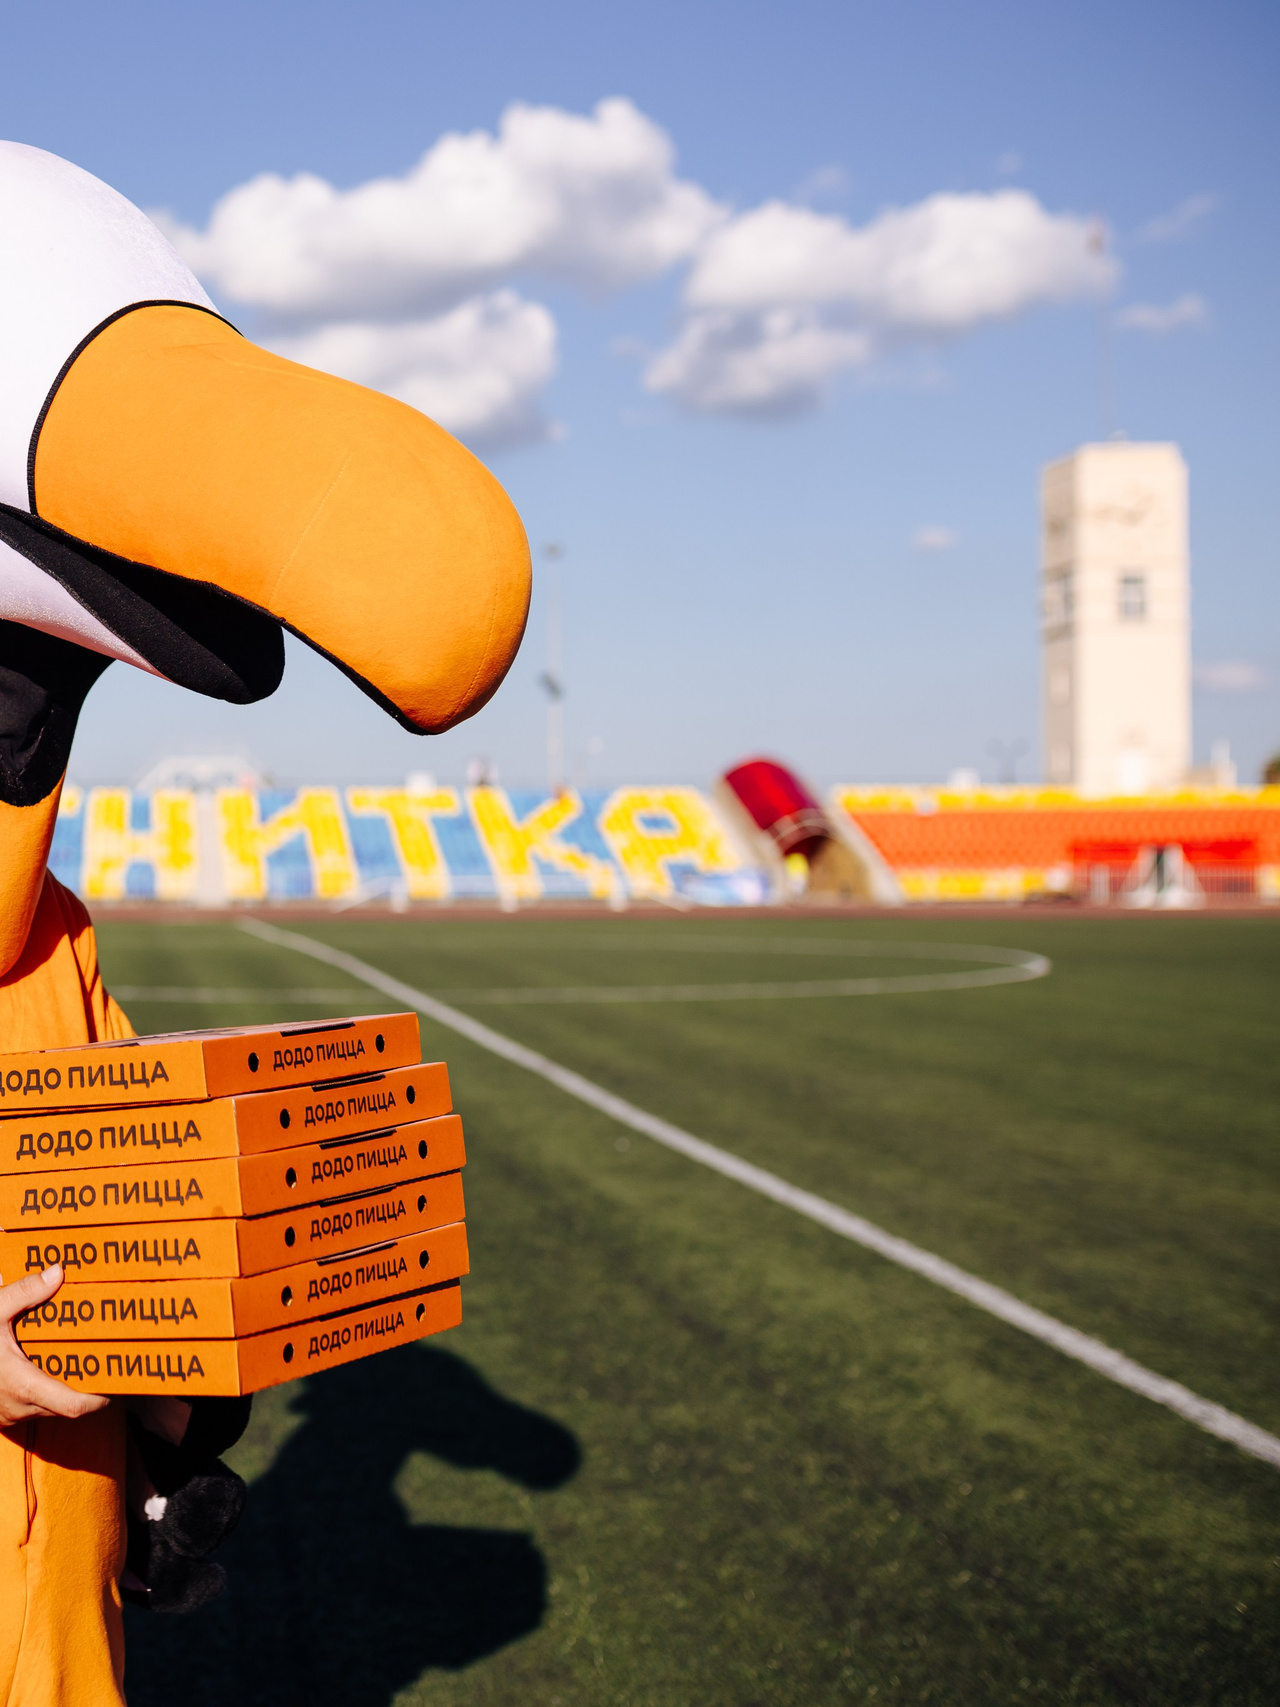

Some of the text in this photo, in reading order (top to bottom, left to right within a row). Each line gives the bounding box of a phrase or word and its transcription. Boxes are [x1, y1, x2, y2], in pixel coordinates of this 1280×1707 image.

[58, 785, 740, 898] НИТКА
[273, 1039, 365, 1072] ДОДО ПИЦЦА
[68, 1061, 169, 1090] ПИЦЦА
[304, 1091, 396, 1128] ДОДО ПИЦЦА
[16, 1120, 202, 1161] ДОДО ПИЦЦА
[311, 1144, 407, 1184] ДОДО ПИЦЦА
[21, 1178, 203, 1215] ДОДО ПИЦЦА
[310, 1200, 407, 1242] ДОДО ПИЦЦА
[25, 1238, 201, 1272] ДОДО ПИЦЦА
[307, 1257, 408, 1302] ДОДО ПИЦЦА
[22, 1298, 198, 1328] ДОДО ПИЦЦА
[308, 1311, 405, 1359] ДОДО ПИЦЦА
[106, 1354, 205, 1382] ПИЦЦА
